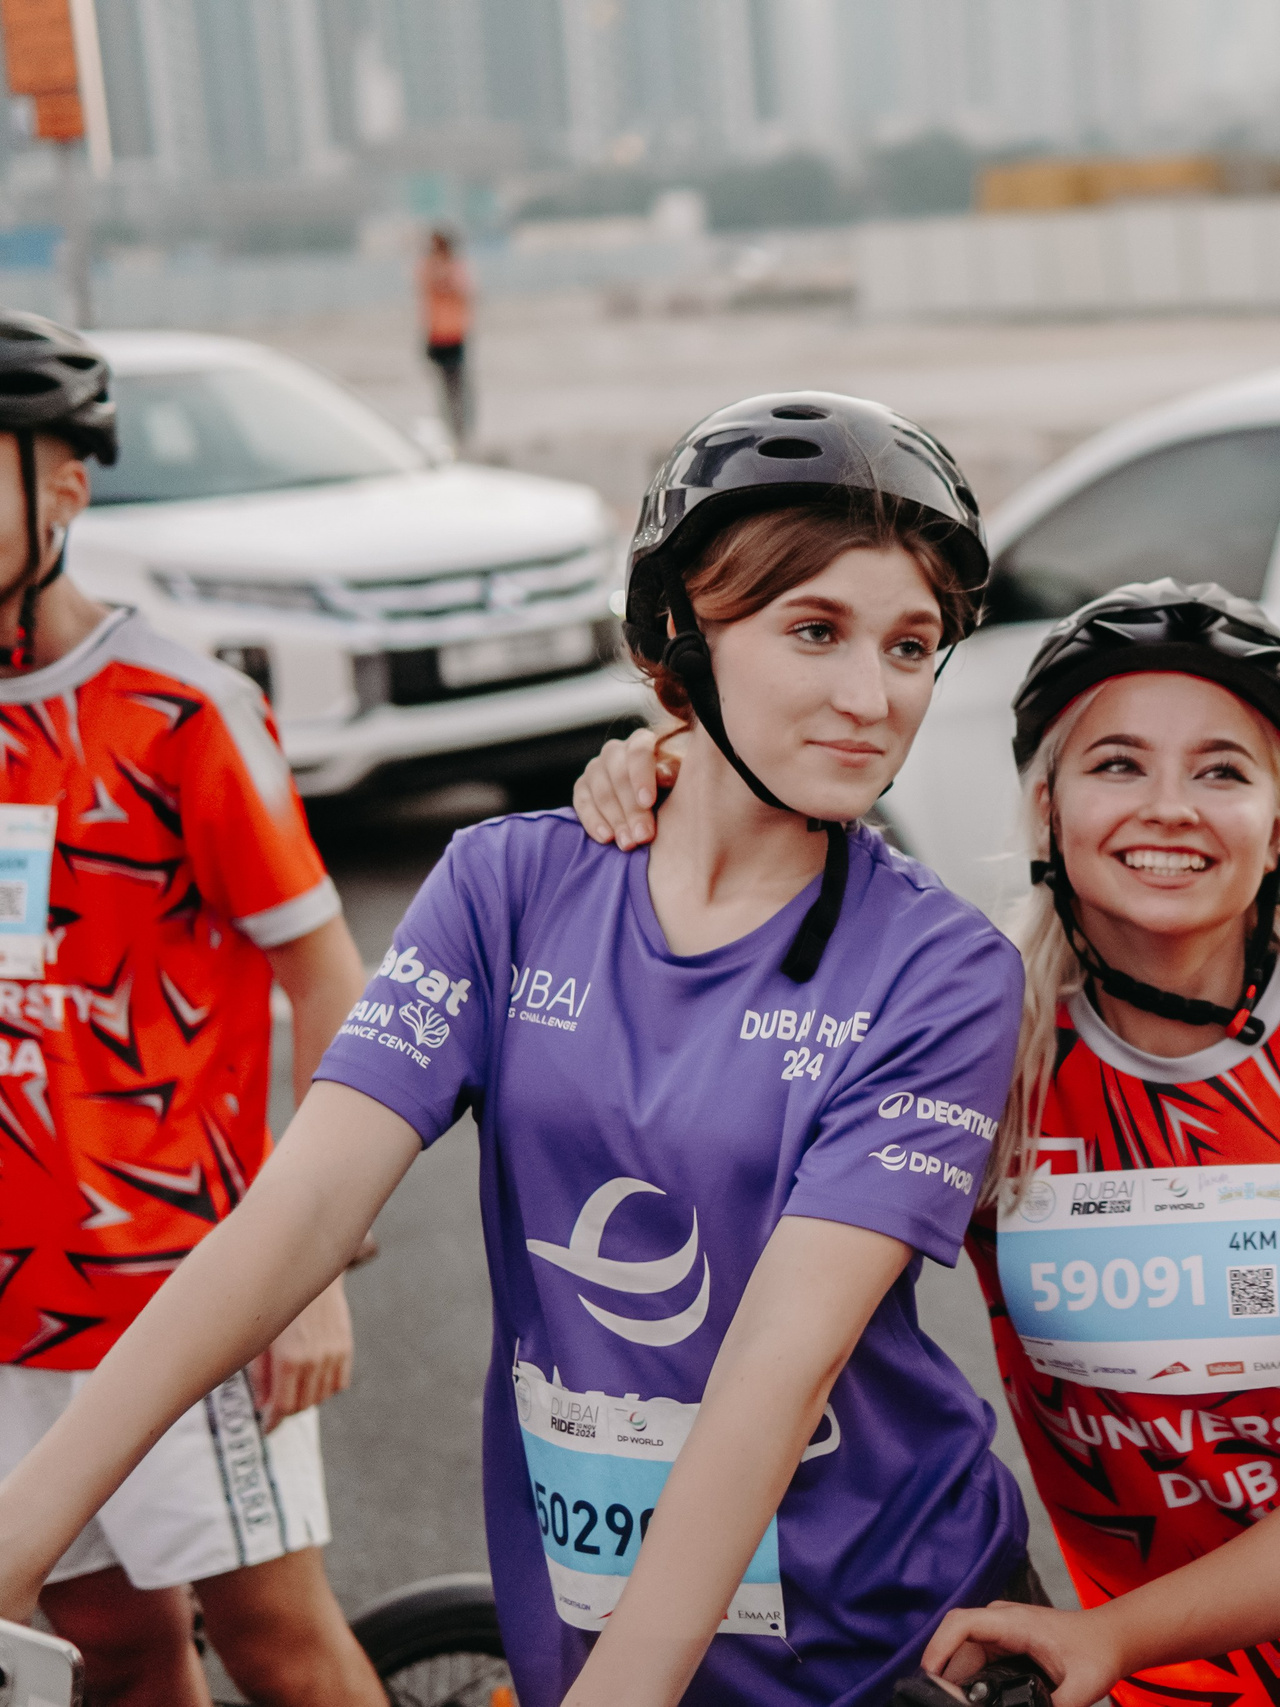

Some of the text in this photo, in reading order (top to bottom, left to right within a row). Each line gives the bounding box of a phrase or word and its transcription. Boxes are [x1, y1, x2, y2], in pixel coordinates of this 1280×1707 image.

[374, 945, 472, 1017] abat
[347, 1000, 395, 1027] AIN
[519, 1010, 578, 1032] CHALLENGE
[378, 1032, 431, 1069] CENTRE
[781, 1046, 825, 1081] 224
[908, 1151, 941, 1175] DP
[1072, 1180, 1135, 1201] DUBAI
[1070, 1201, 1108, 1215] RIDE
[1170, 1202, 1205, 1211] WORLD
[1228, 1230, 1278, 1251] 4KM
[1030, 1255, 1206, 1312] 59091
[551, 1396, 599, 1423] DUBAI
[551, 1416, 575, 1436] RIDE
[575, 1428, 597, 1439] 2024
[617, 1435, 664, 1447] DP WORLD
[738, 1609, 782, 1621] EMAAR
